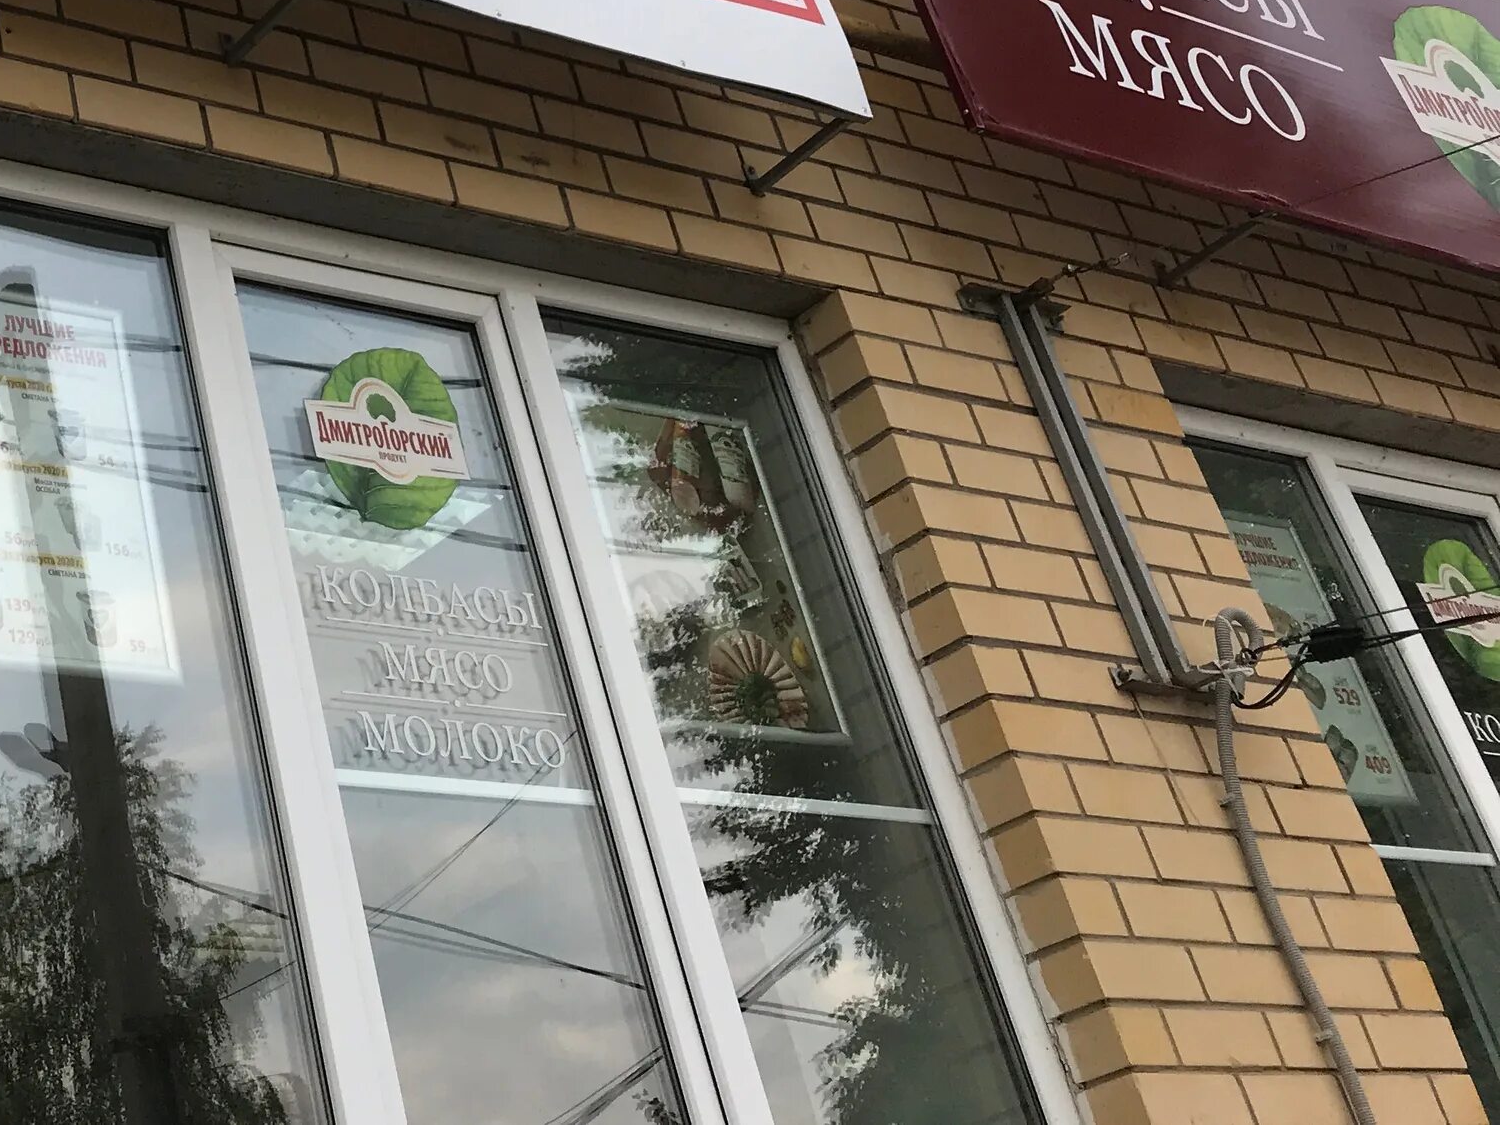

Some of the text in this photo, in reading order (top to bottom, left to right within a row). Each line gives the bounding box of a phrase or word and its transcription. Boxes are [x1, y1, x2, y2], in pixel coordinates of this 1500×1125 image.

[4, 315, 75, 341] ЛУЧШИЕ
[315, 565, 543, 629] КОЛБАСЫ
[378, 641, 513, 693] МЯСО
[1333, 685, 1361, 706] 529
[357, 710, 566, 768] МОЛОКО
[1365, 755, 1392, 774] 409
